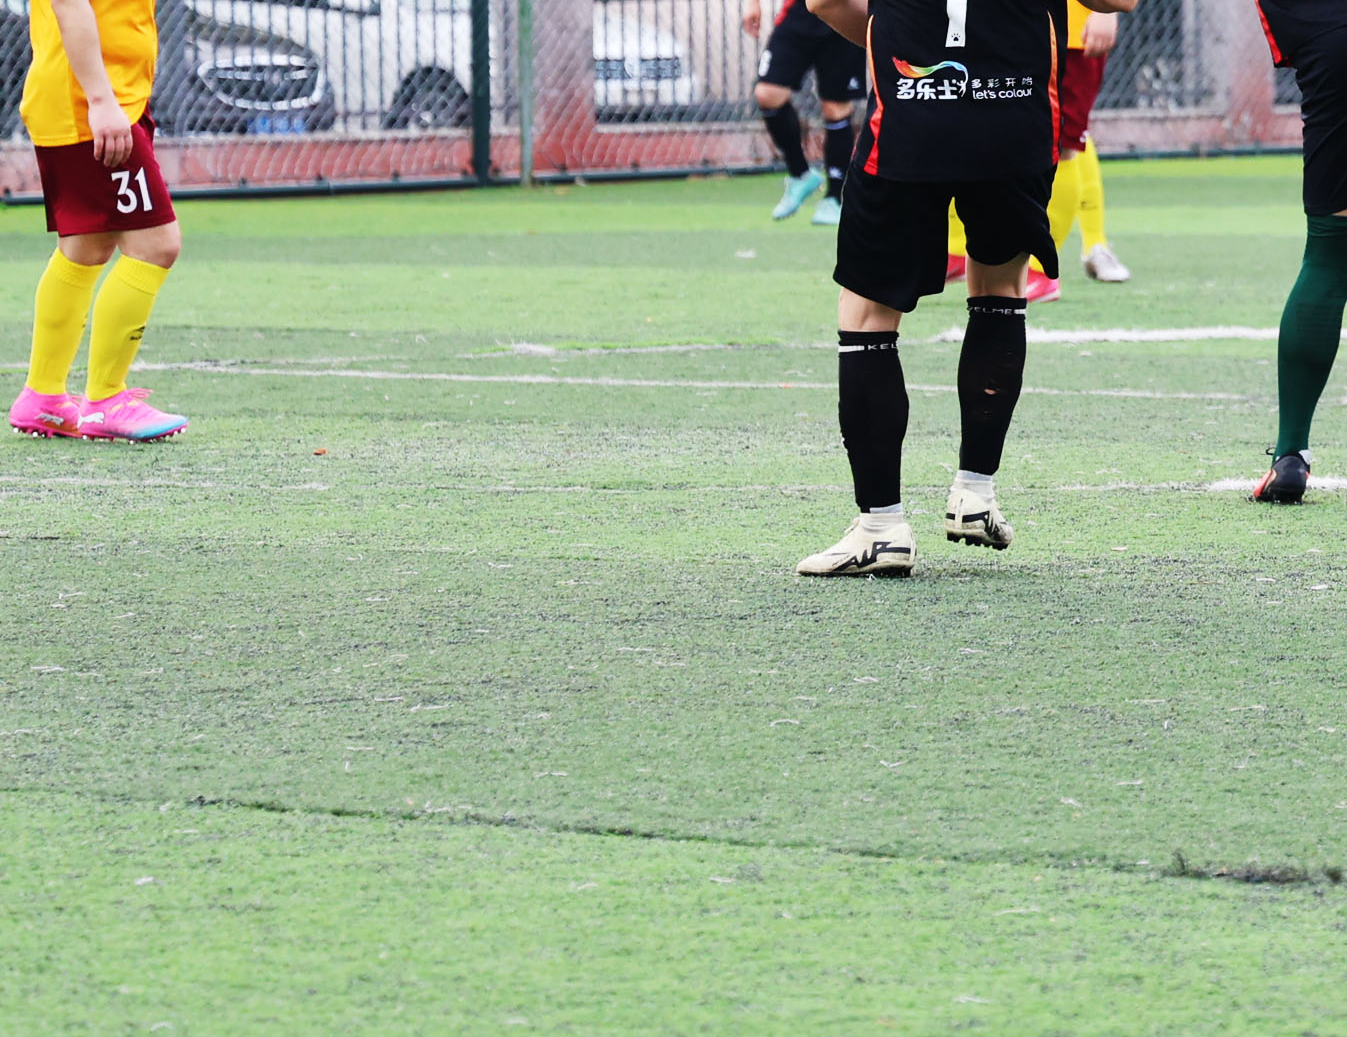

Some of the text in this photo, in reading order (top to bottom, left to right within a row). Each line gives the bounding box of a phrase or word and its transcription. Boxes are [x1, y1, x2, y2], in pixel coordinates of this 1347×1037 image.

[896, 78, 958, 100] 多乐士
[971, 76, 1033, 89] 多彩开始
[972, 87, 1032, 100] let's colour
[111, 167, 152, 214] 31
